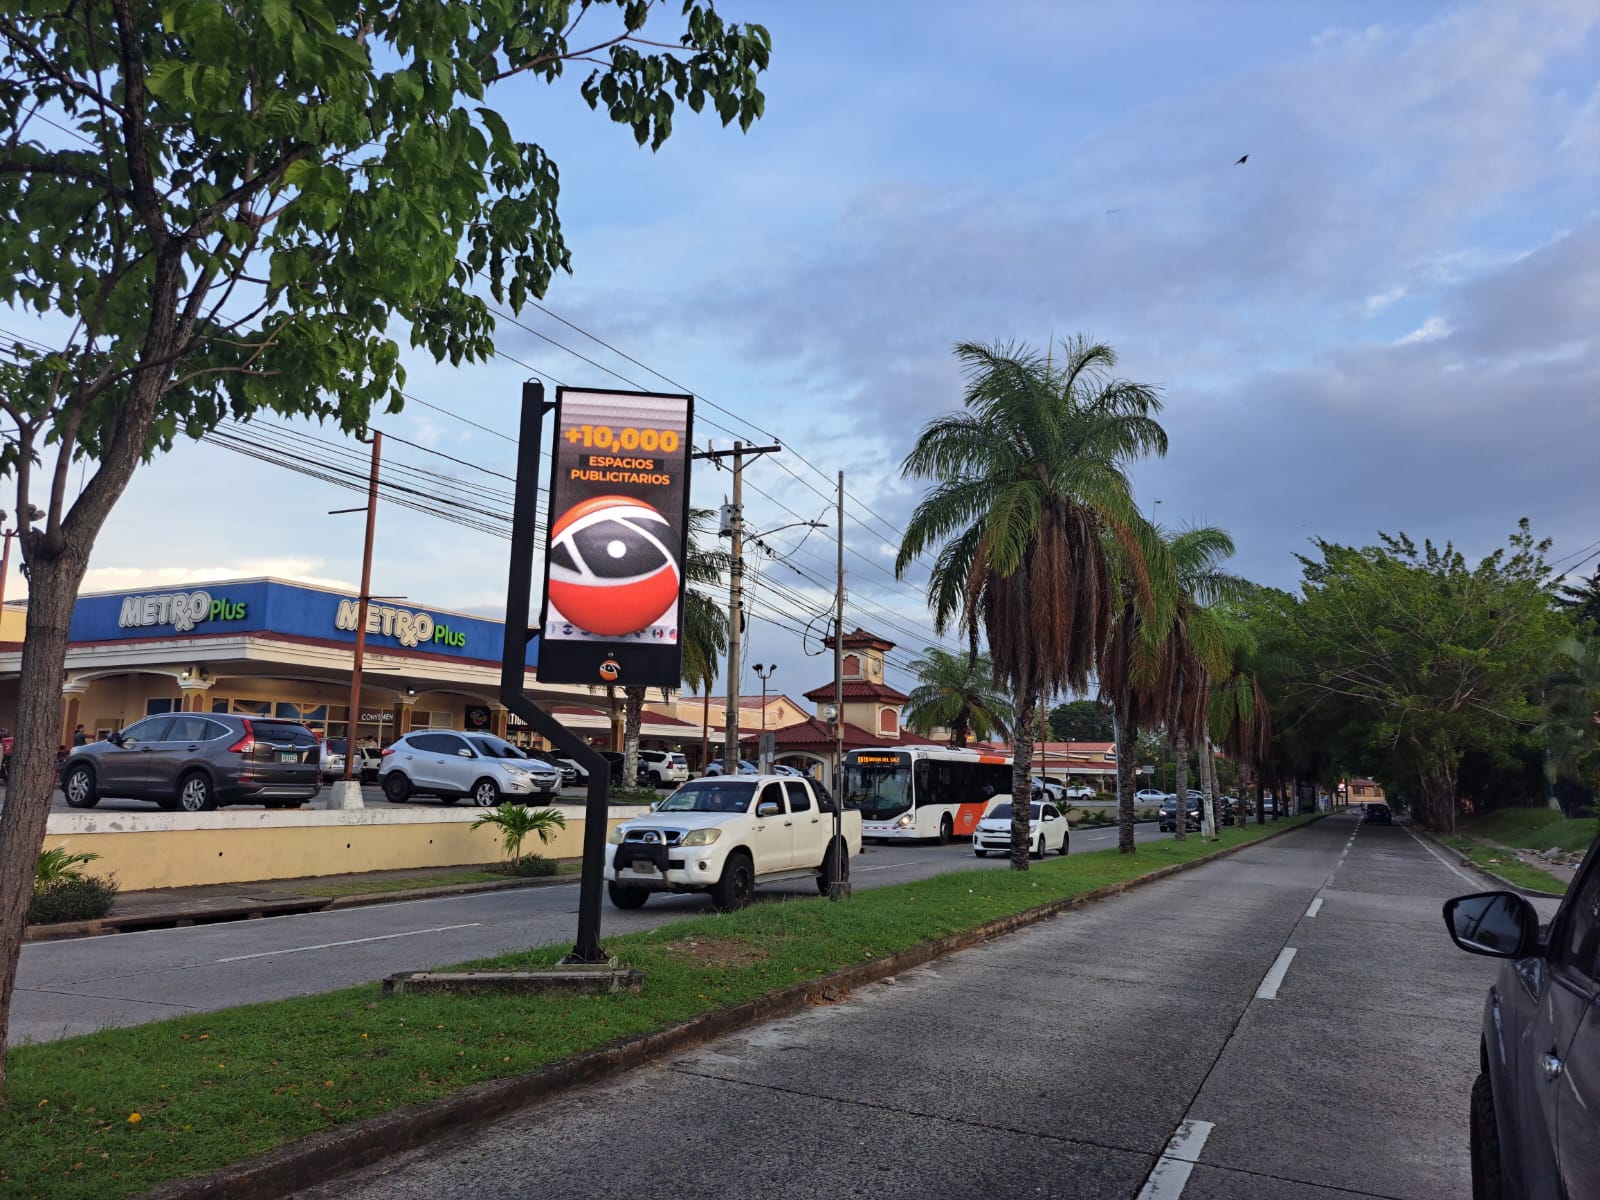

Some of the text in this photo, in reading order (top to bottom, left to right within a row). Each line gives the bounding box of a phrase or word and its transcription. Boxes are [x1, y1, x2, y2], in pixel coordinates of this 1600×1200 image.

[565, 425, 679, 453] +10,000
[588, 455, 654, 470] ESPACIOS
[570, 469, 670, 485] PUBLICITARIOS
[118, 590, 246, 632] METRO Plus
[335, 599, 467, 647] METRO Plus
